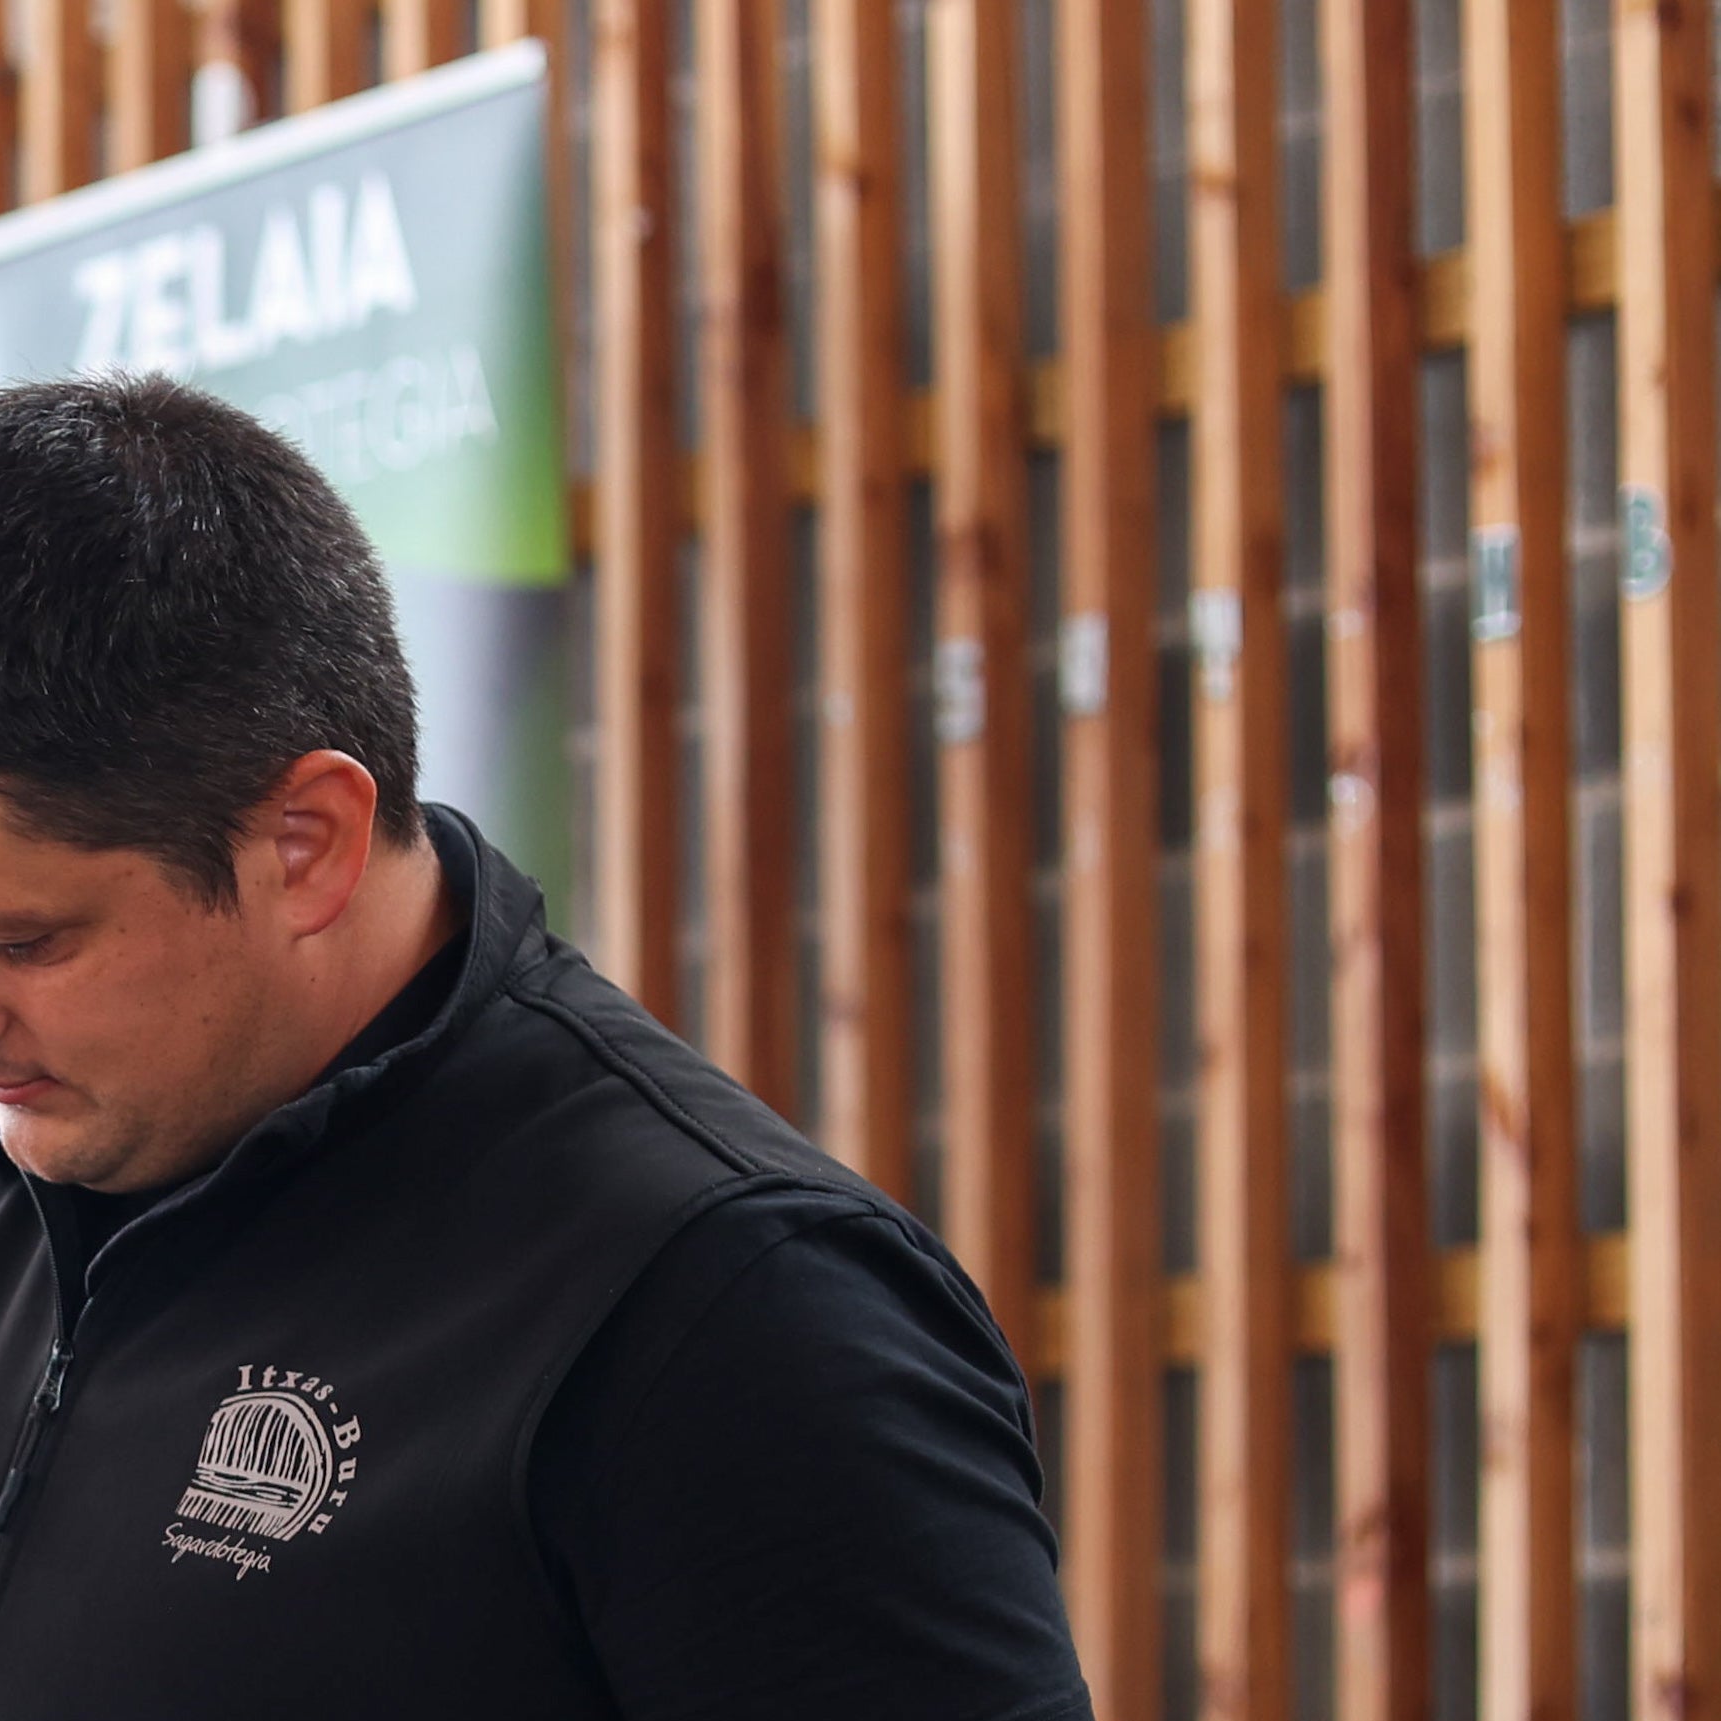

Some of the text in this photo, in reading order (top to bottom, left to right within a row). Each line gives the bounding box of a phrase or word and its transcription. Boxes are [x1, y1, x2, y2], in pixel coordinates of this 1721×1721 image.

[70, 168, 417, 379] ZELAIA
[236, 1364, 361, 1534] Itxas-Buru
[161, 1522, 272, 1581] Sagardotegia
